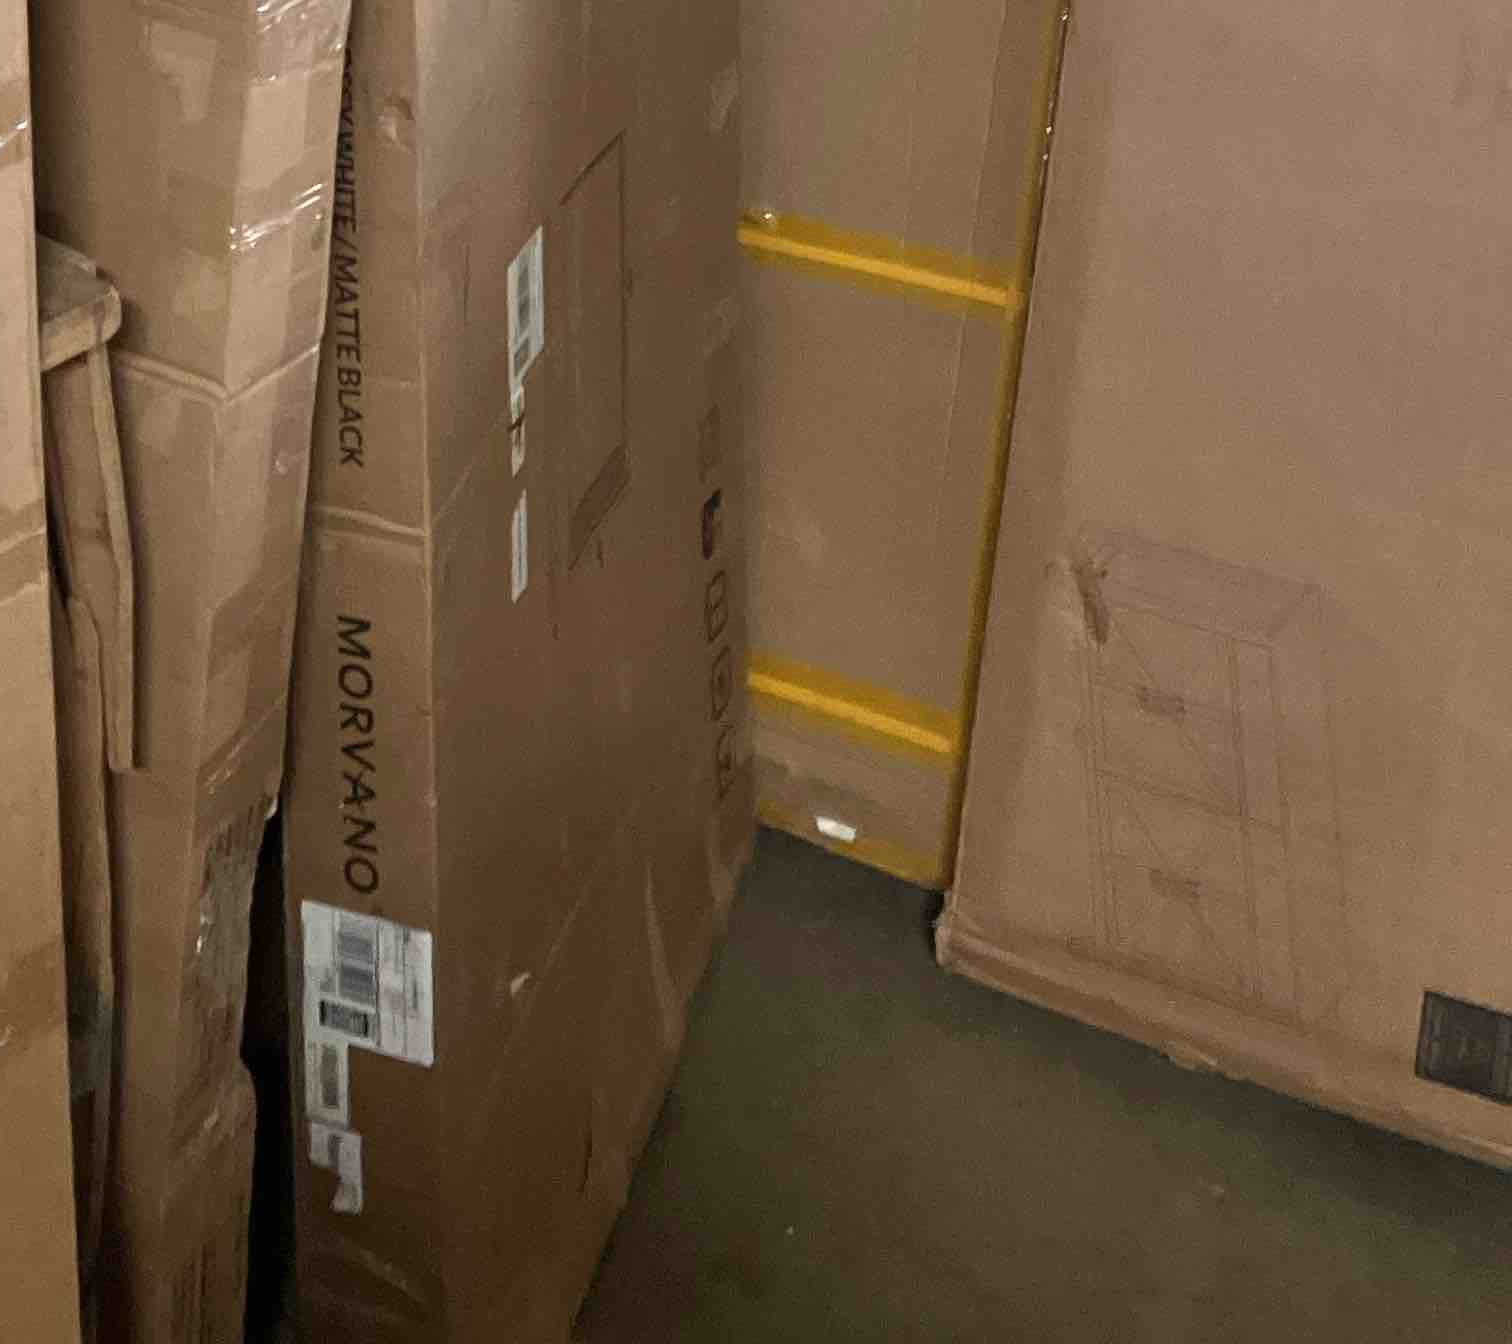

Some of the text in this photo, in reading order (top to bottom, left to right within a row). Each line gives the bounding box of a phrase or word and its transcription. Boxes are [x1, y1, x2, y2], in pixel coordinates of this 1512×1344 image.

[334, 253, 362, 364] MATTE
[337, 367, 365, 469] BLACK
[335, 614, 380, 896] MORVANO
